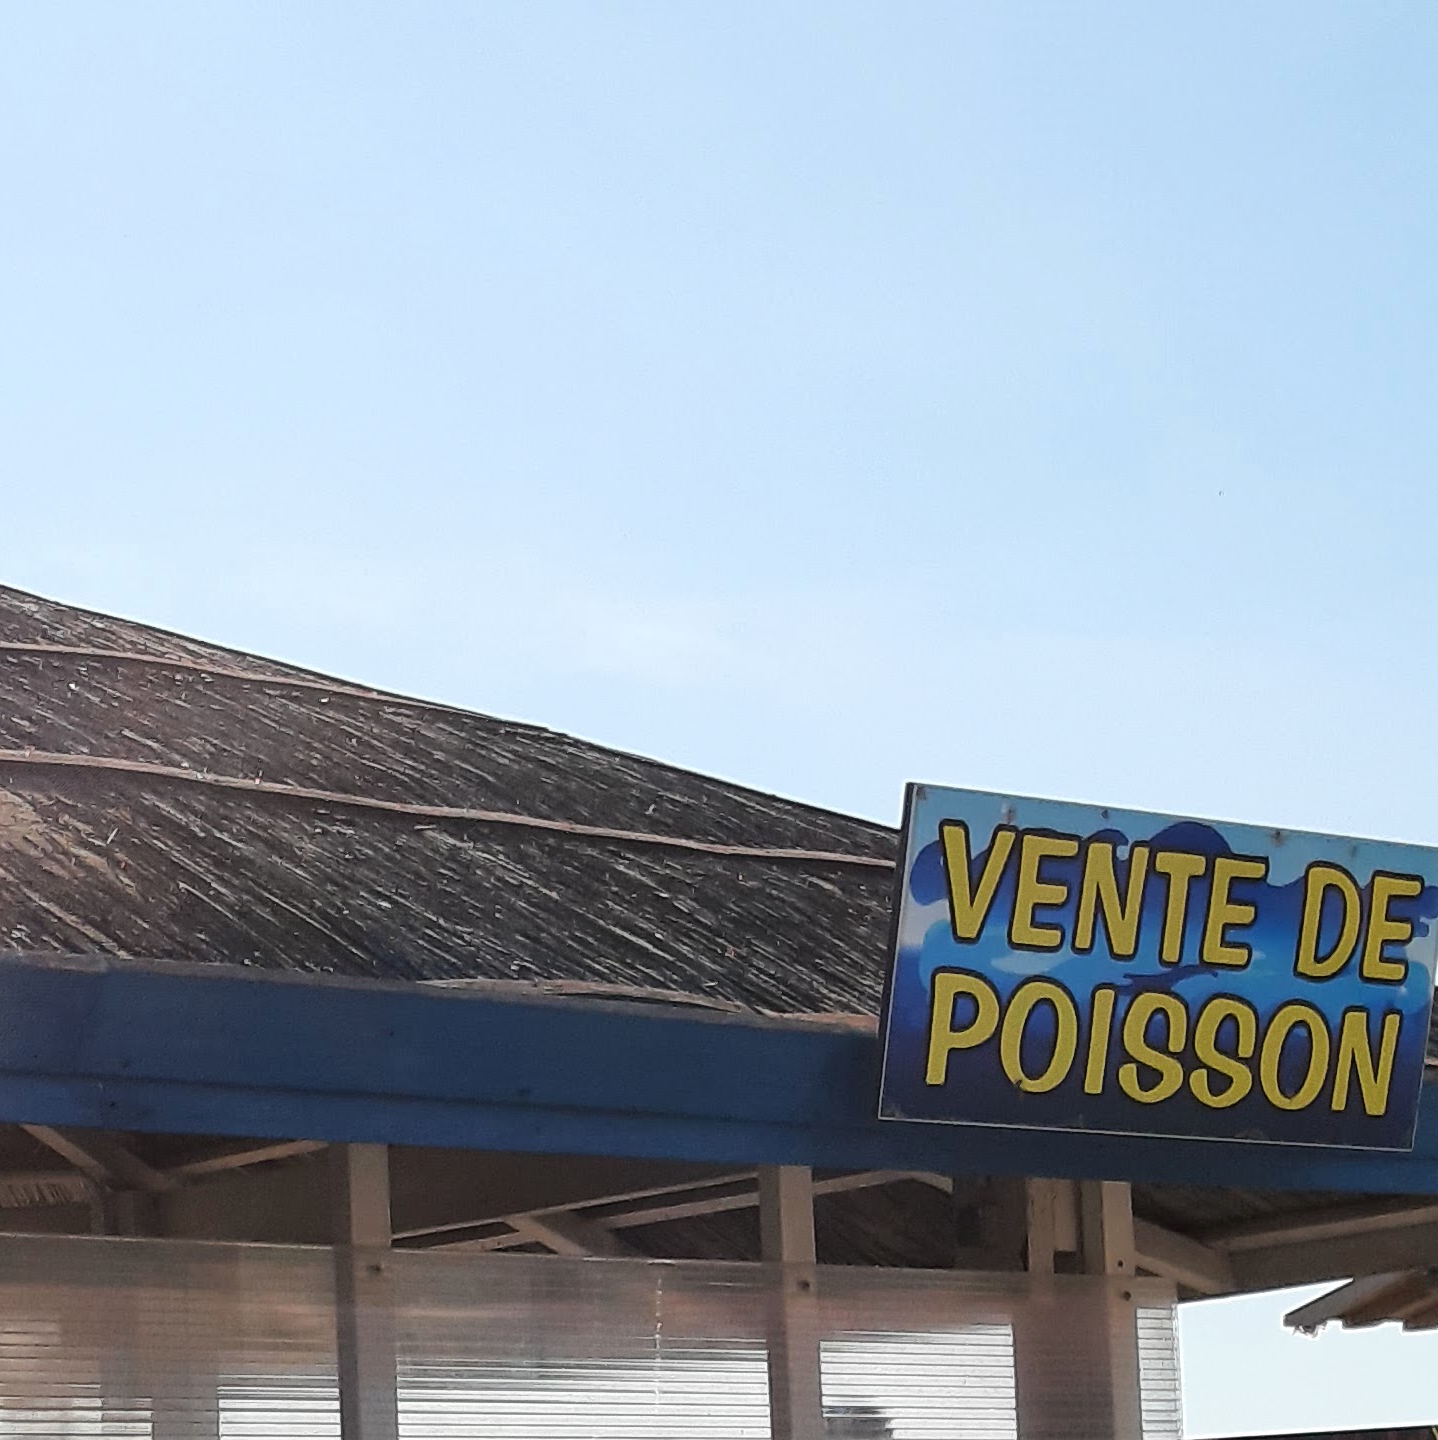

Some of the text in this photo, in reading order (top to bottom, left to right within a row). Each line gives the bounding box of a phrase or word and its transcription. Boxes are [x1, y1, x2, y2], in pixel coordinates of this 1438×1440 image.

[939, 819, 1425, 983] VENTE DE
[924, 967, 1401, 1117] POISSON
